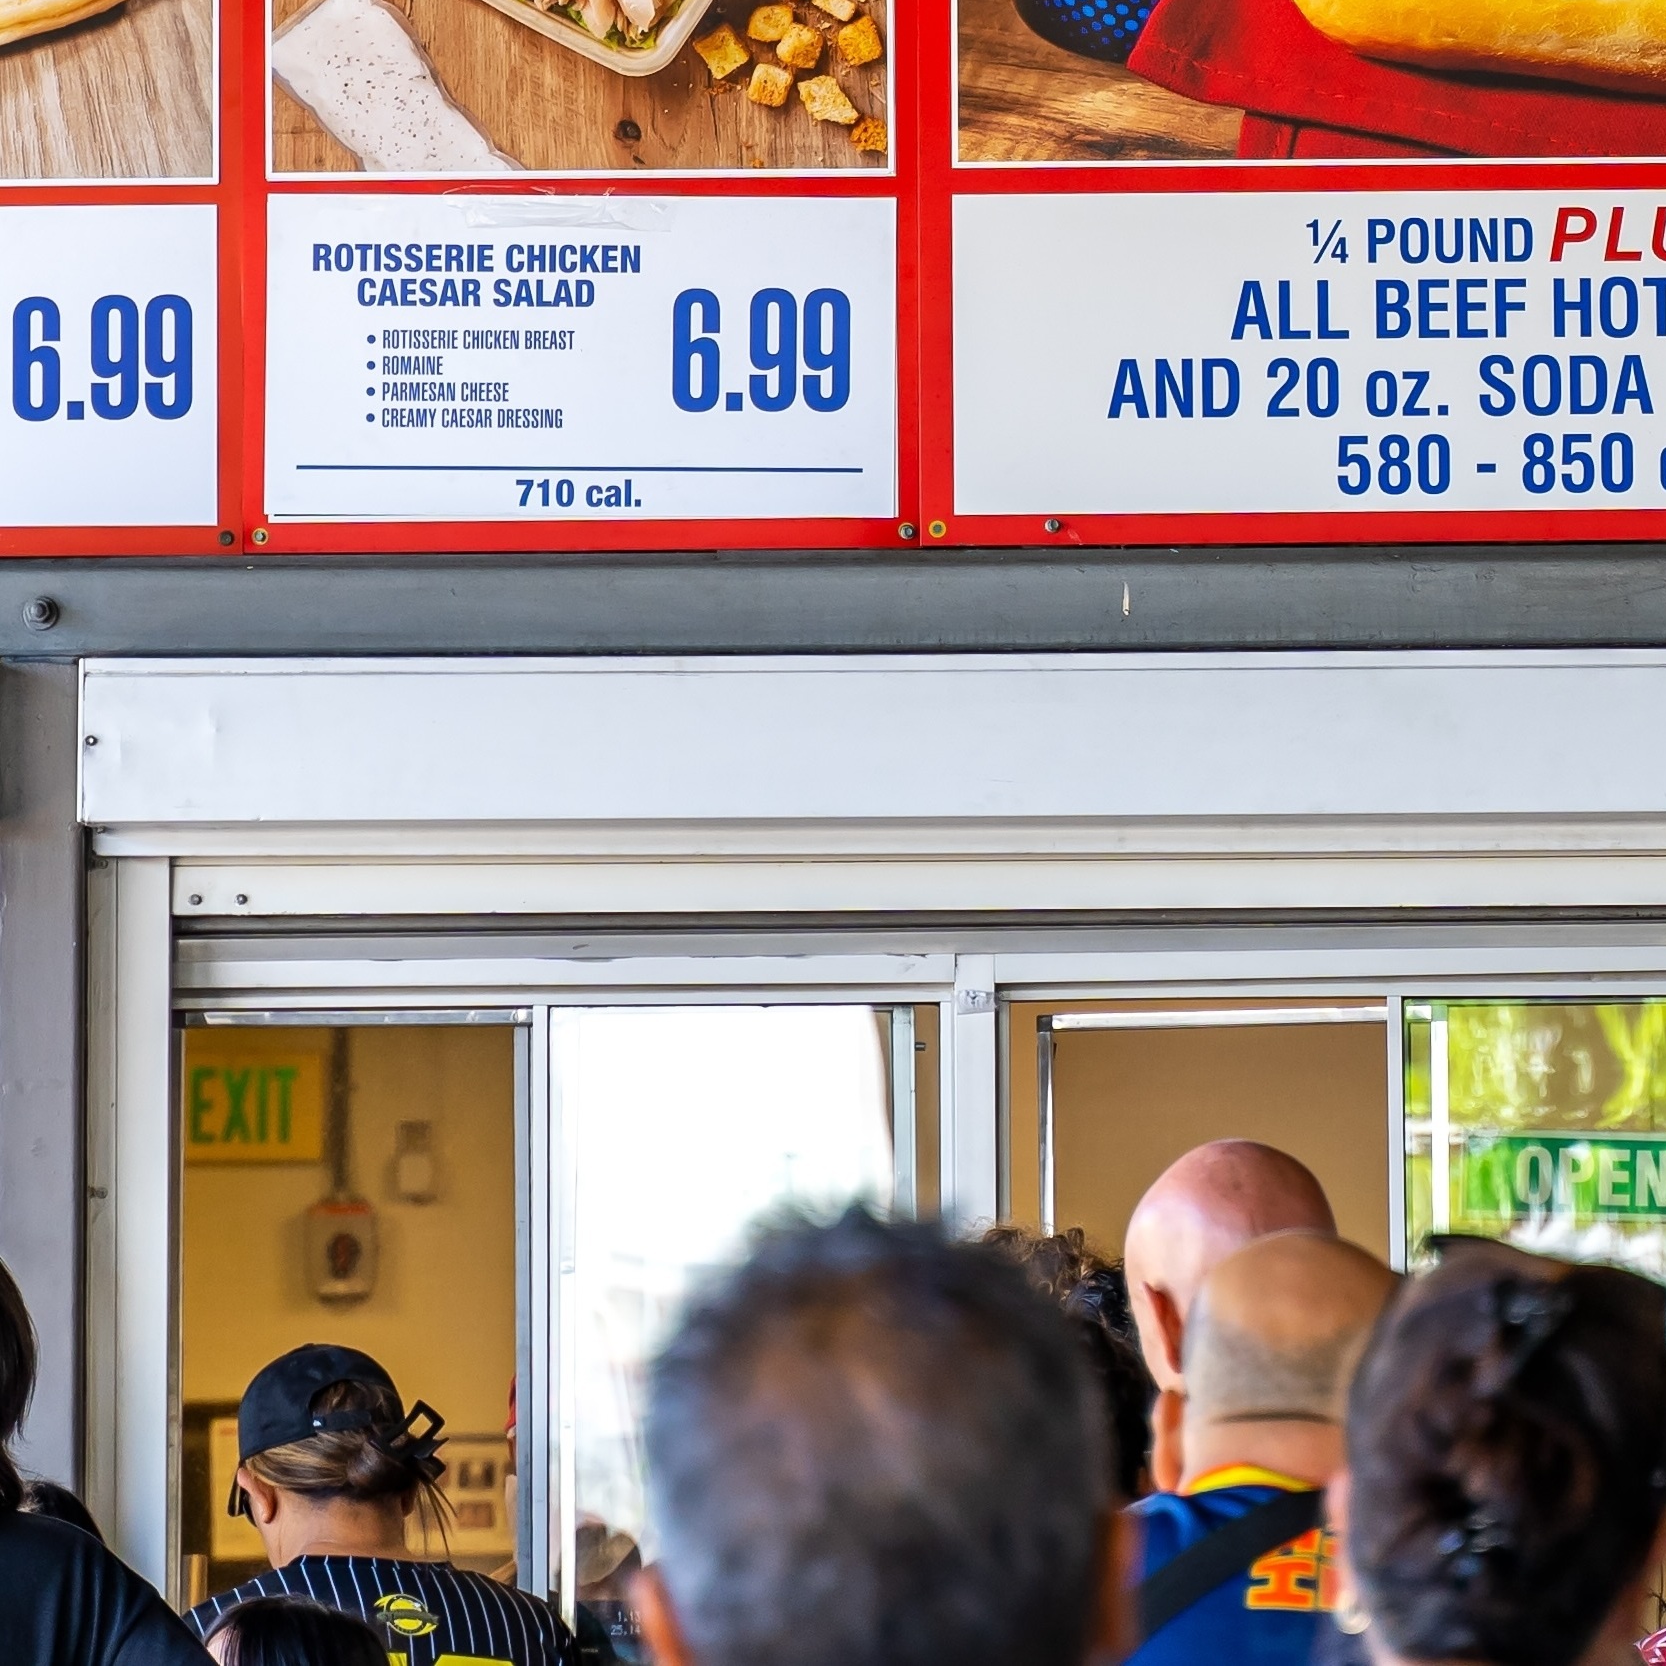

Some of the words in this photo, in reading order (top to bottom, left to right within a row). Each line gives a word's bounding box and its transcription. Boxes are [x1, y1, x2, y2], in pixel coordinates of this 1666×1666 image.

[313, 244, 493, 272] ROTISSERIE
[506, 244, 640, 273] CHICKEN
[1368, 218, 1533, 264] POUND
[358, 278, 480, 306] CAESAR
[493, 279, 594, 307] SALAD
[1231, 280, 1349, 340] ALL
[1376, 279, 1526, 338] BEEF
[13, 294, 192, 421] 6.99
[383, 330, 458, 349] ROTISSERIE
[464, 330, 519, 349] CHICKEN
[525, 331, 575, 350] BREAST
[673, 288, 850, 412] 6.99
[383, 356, 443, 375] ROMAINE
[383, 382, 455, 401] PARMESAN
[462, 382, 508, 402] CHEESE
[1108, 358, 1240, 418] AND
[1267, 357, 1339, 418] 20
[1366, 370, 1448, 417] oz.
[1480, 355, 1654, 416] SODA
[382, 408, 436, 427] CREAMY
[442, 409, 492, 428] CAESAR
[498, 409, 562, 428] DRESSING
[1338, 434, 1450, 495] 580
[1522, 432, 1633, 494] 850
[516, 479, 574, 507] 710
[586, 479, 641, 507] cal.
[191, 1066, 298, 1144] EXIT
